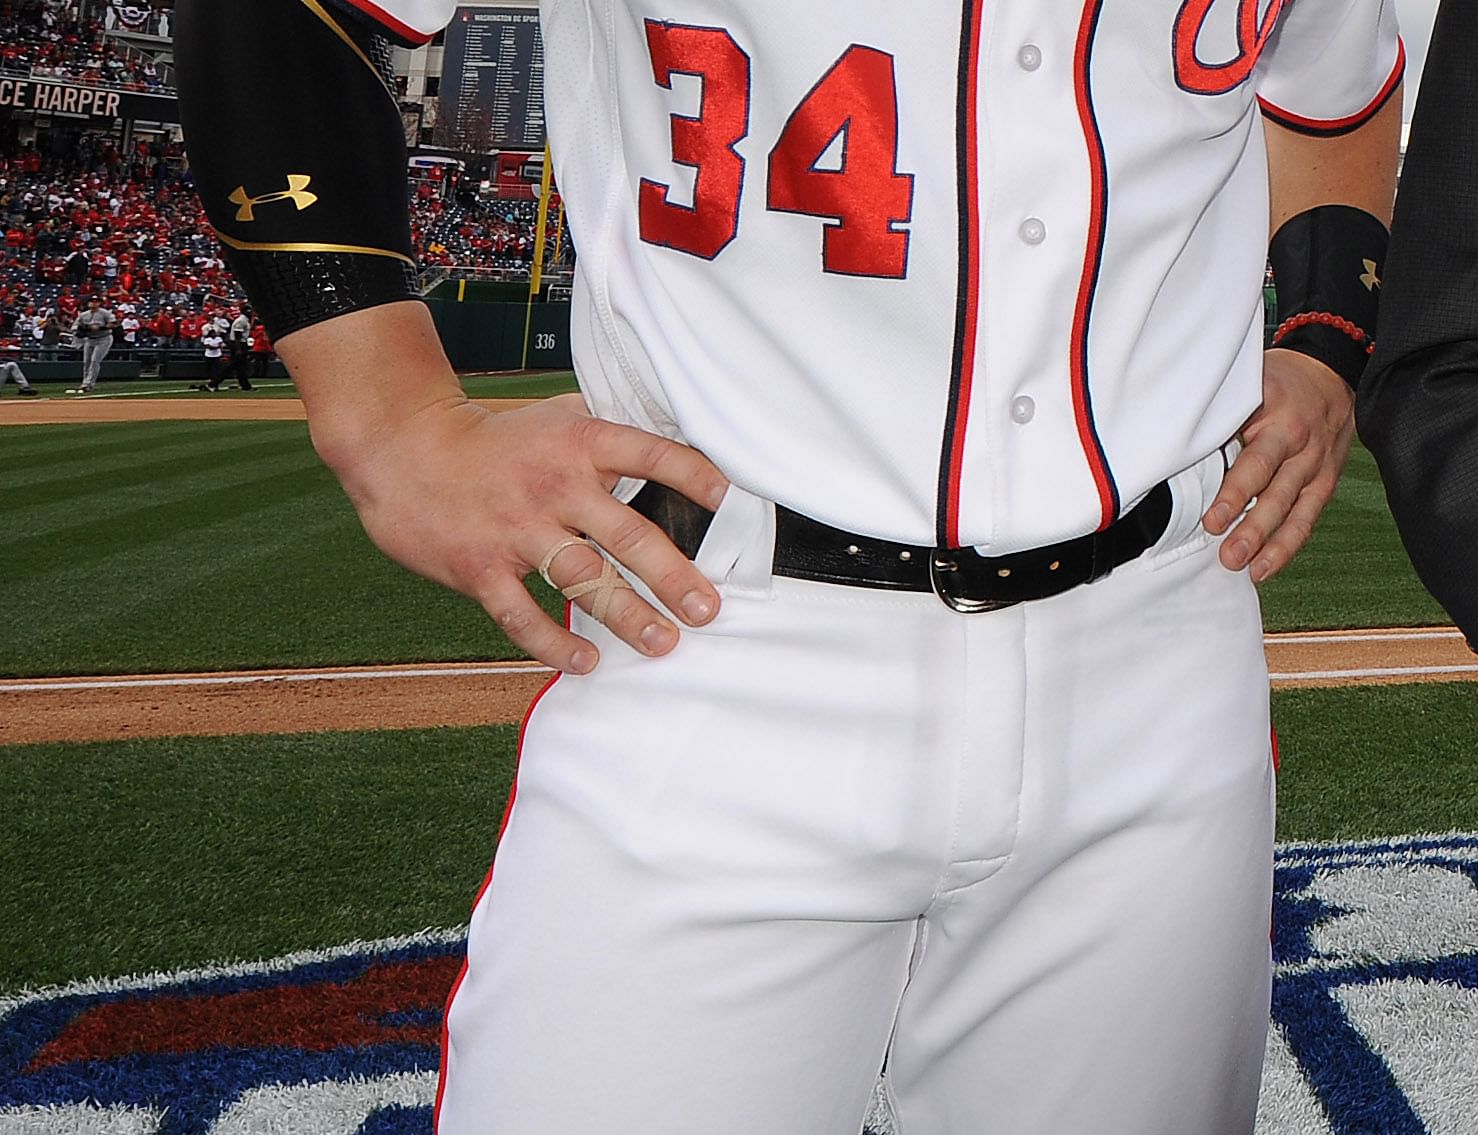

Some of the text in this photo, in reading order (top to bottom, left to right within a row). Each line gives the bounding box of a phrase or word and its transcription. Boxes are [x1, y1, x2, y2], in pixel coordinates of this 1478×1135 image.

[33, 83, 120, 117] HARPER
[638, 17, 916, 280] 34
[534, 333, 556, 350] 336
